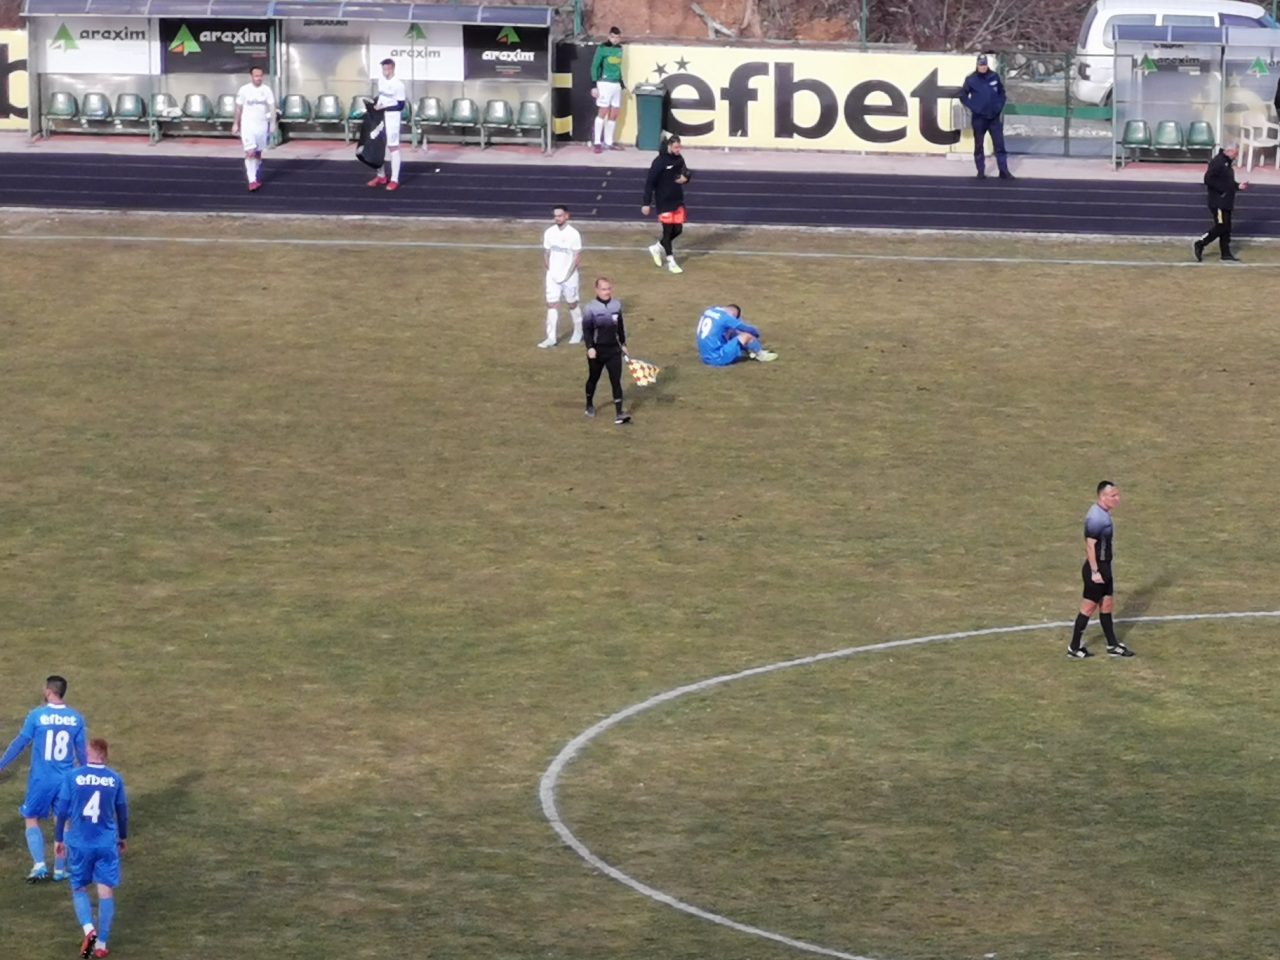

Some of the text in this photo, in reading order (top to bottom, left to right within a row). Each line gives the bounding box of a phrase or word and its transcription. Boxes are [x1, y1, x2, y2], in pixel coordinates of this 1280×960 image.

[661, 61, 962, 146] efbet
[39, 713, 78, 726] efbet
[44, 729, 70, 761] 18
[75, 773, 116, 787] efbet
[82, 790, 101, 824] 4
